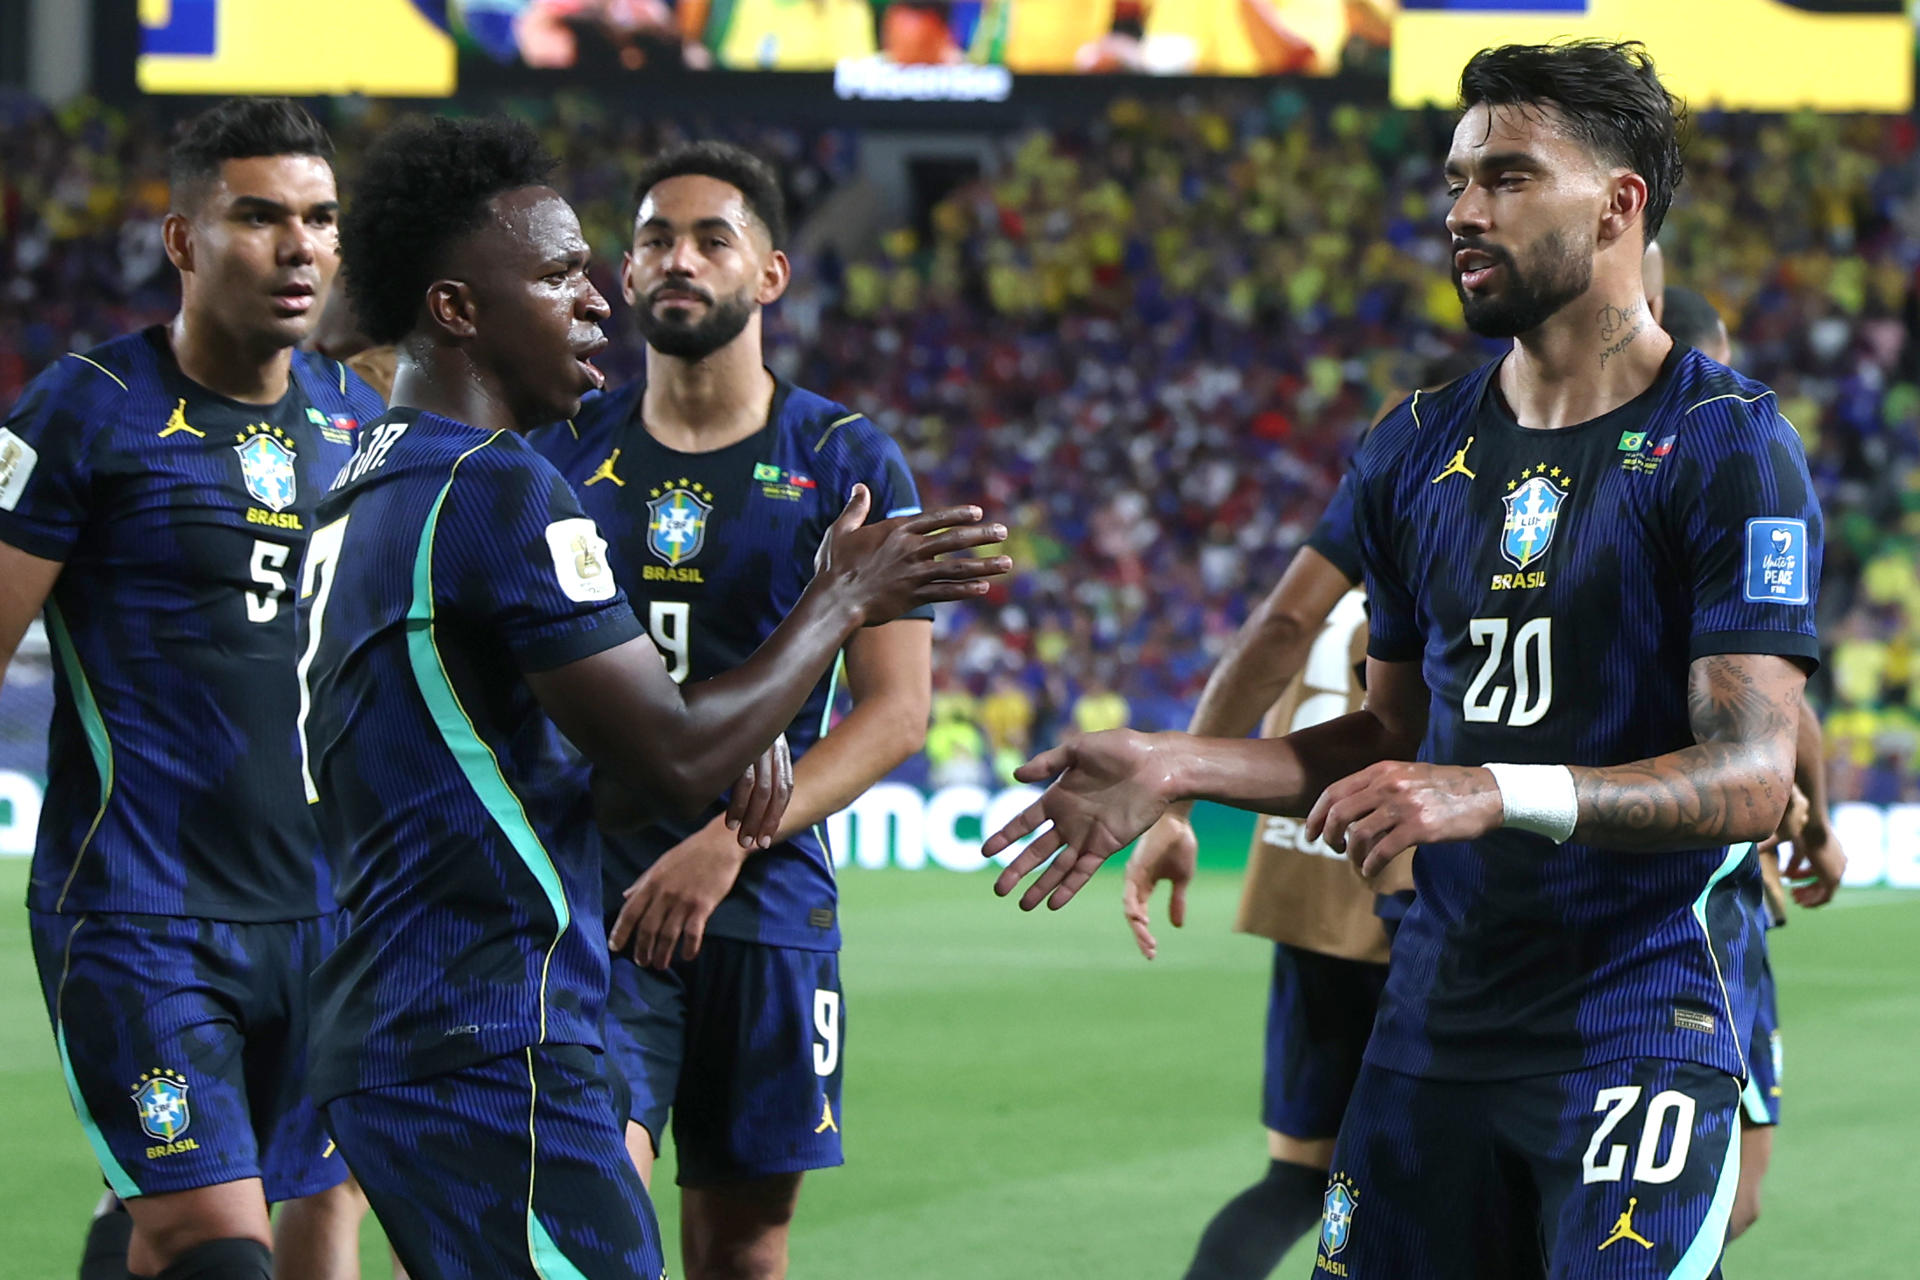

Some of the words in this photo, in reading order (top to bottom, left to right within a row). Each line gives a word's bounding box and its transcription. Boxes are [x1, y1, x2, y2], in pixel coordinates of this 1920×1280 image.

[246, 507, 303, 530] BRASIL
[245, 540, 290, 623] 5
[643, 565, 704, 583] BRASIL
[1491, 571, 1546, 590] BRASIL
[1764, 570, 1794, 585] PEACE
[297, 513, 349, 804] 7
[650, 601, 690, 684] 9
[1463, 617, 1552, 727] 20
[813, 989, 839, 1077] 9
[146, 1138, 200, 1159] BRASIL
[1582, 1086, 1696, 1185] 20
